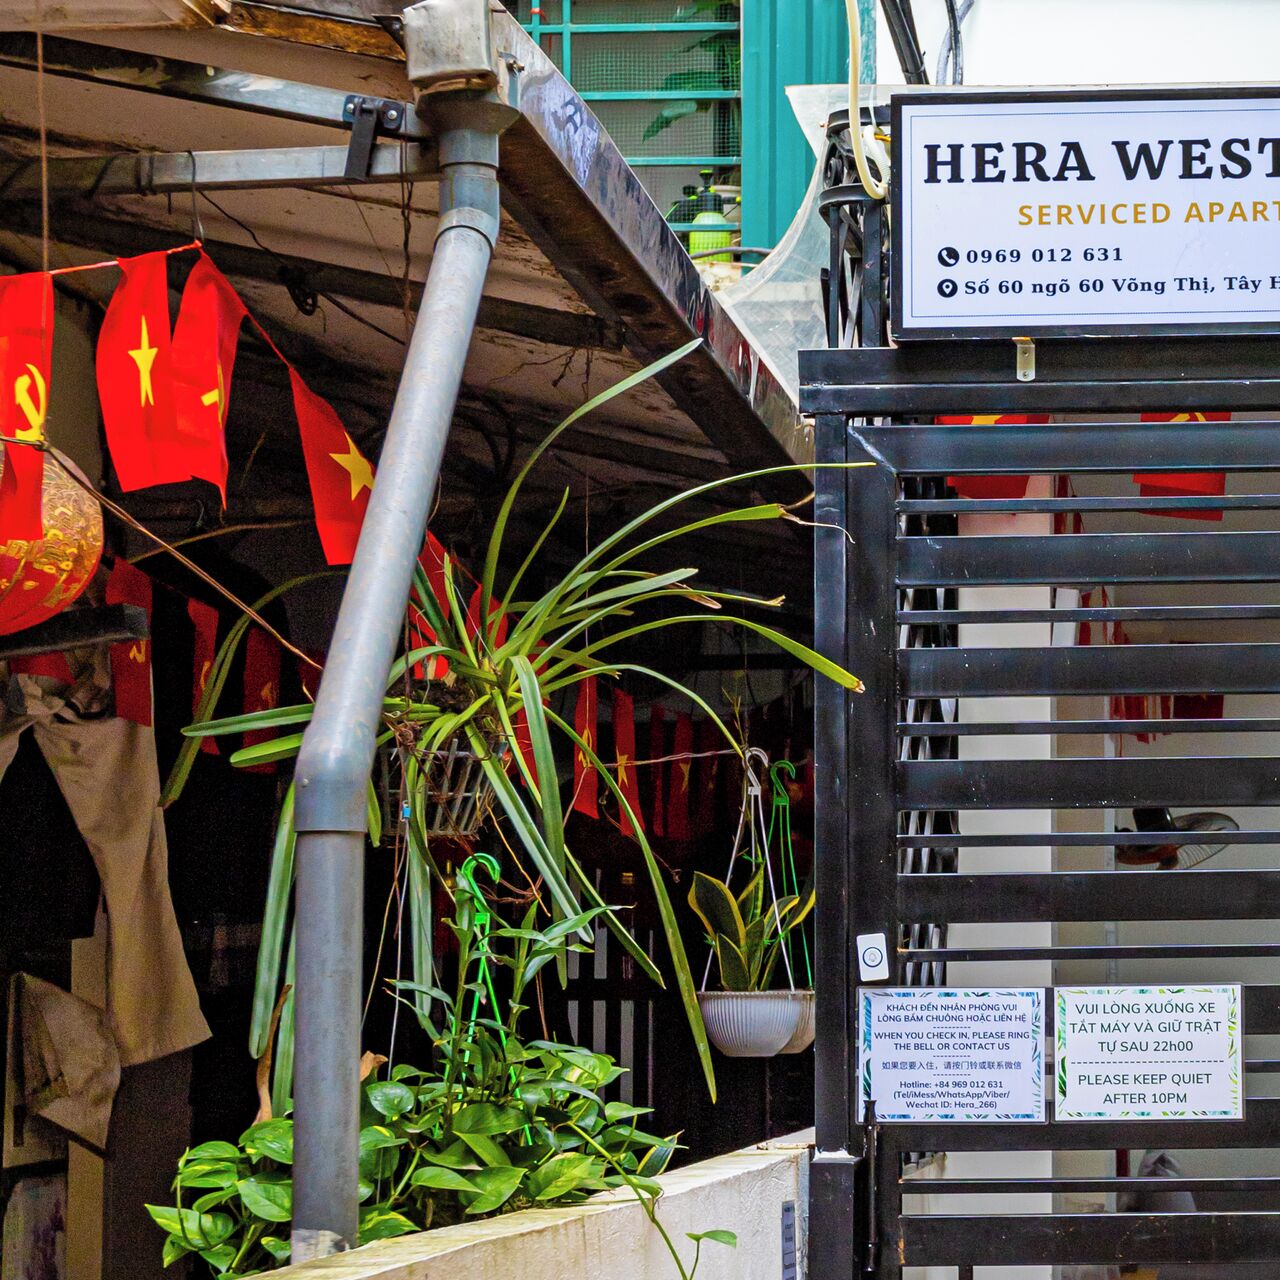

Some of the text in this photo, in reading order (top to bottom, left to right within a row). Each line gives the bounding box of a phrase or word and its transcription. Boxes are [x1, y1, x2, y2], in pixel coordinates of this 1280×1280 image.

[924, 142, 1096, 183] HERA
[1019, 203, 1170, 225] SERVICED
[967, 248, 1122, 263] 0969 012 631
[965, 279, 989, 294] Số
[999, 280, 1023, 294] 60
[1032, 279, 1070, 296] ngõ
[1079, 279, 1103, 292] 60
[1112, 278, 1166, 295] Võng
[1174, 277, 1214, 293] Thị,
[1224, 276, 1262, 293] Tây
[887, 1002, 917, 1011] KHÁCH
[969, 1002, 1000, 1011] PHÒNG
[1075, 999, 1215, 1014] VUI LÒNG XUỐNG XE
[878, 1013, 901, 1022] LÒNG
[1070, 1019, 1221, 1034] TẮT MÁY VÀ GIỮ TRẬT
[959, 1032, 969, 1040] IN,
[1098, 1040, 1193, 1054] TỰ SAU 22h00
[1079, 1074, 1212, 1086] PLEASE KEEP QUIET
[894, 1091, 1010, 1100] (Tel/iMess/WhatsApp/Viber/
[1103, 1093, 1186, 1104] AFTER 10PM
[955, 1101, 997, 1109] Hera_266)
